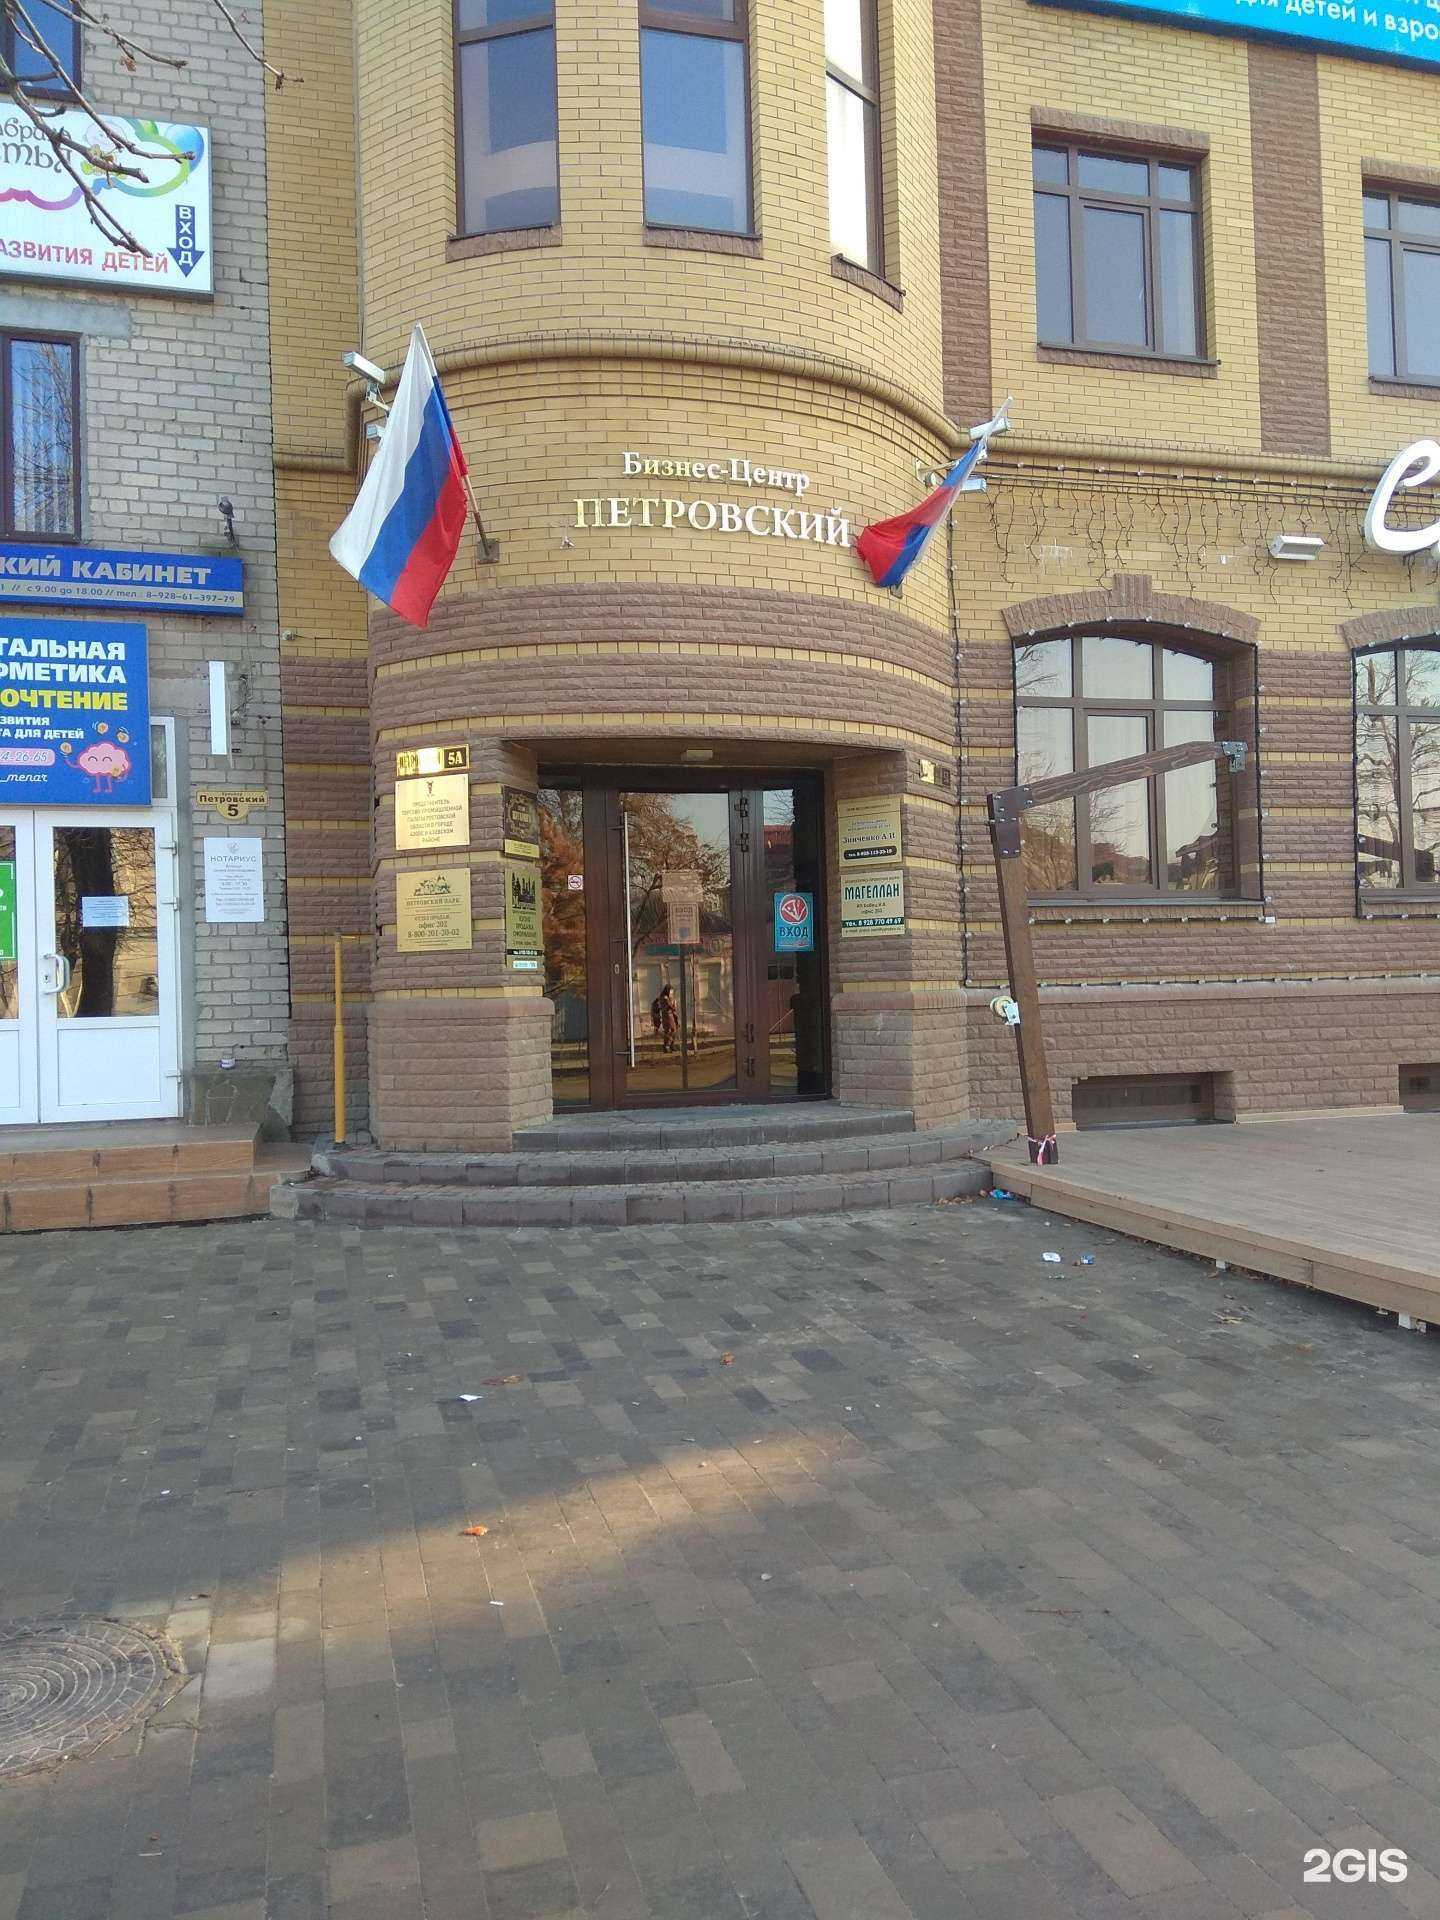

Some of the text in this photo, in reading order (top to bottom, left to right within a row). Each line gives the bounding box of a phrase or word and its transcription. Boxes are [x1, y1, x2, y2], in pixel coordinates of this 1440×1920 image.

[178, 206, 195, 267] ВХОД
[102, 252, 168, 273] ДЕТЕЙ
[622, 451, 811, 497] Бизнес-Центр
[573, 497, 852, 548] ПЕТРОВСКИЙ
[72, 559, 212, 585] КАБИНЕТ
[15, 729, 41, 739] ДЛЯ
[44, 728, 84, 740] ДЕТЕЙ
[200, 795, 265, 804] Петровский
[228, 804, 239, 817] 5
[845, 883, 900, 900] МАГЕЛЛАН
[780, 926, 808, 938] ВХОД
